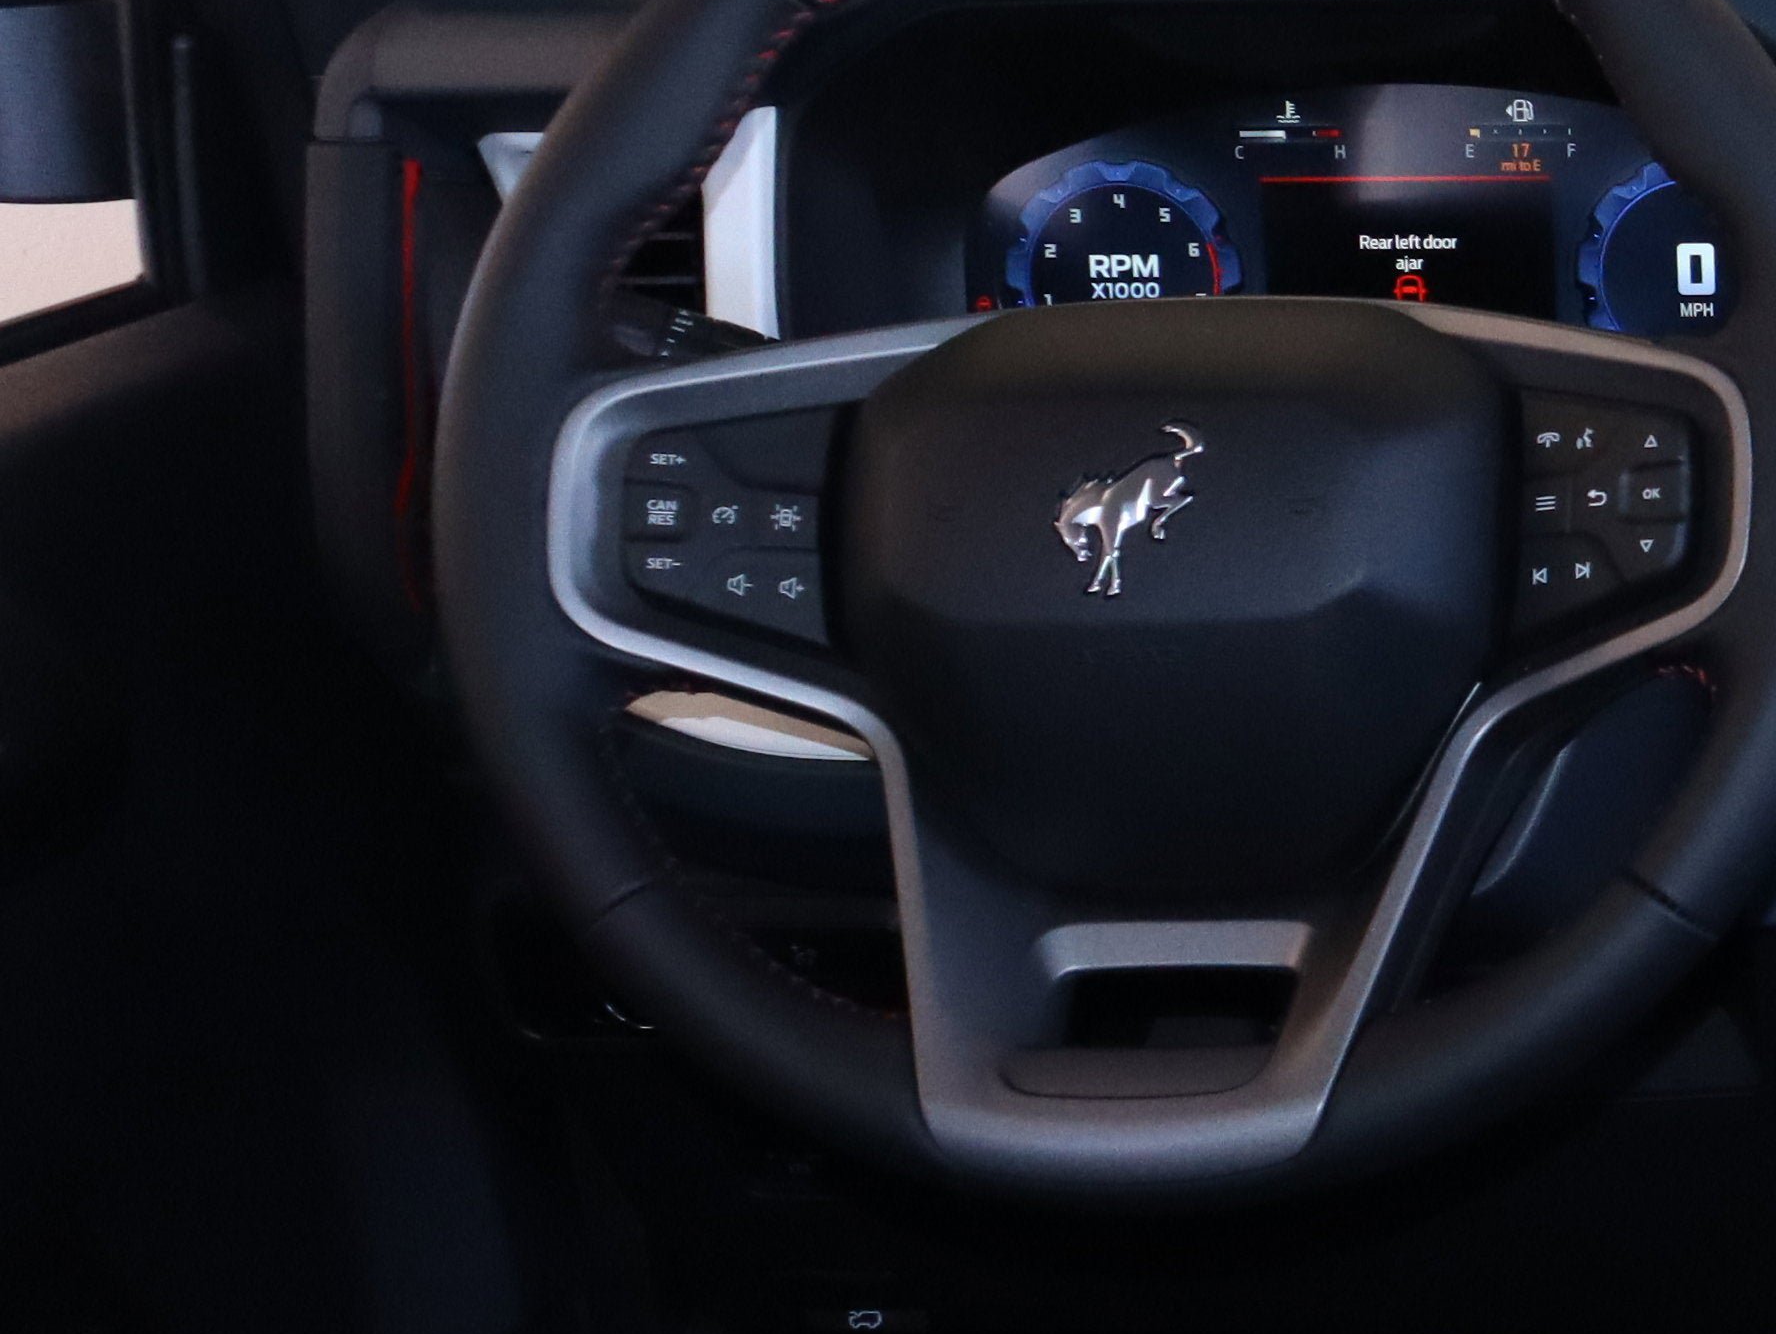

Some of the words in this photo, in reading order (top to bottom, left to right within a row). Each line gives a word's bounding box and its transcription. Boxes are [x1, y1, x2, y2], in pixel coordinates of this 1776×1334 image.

[1234, 145, 1244, 160] C
[1335, 145, 1346, 158] H
[1466, 145, 1475, 158] E
[1511, 143, 1531, 158] 17
[1567, 144, 1576, 158] F
[1113, 193, 1126, 208] 4
[1069, 208, 1082, 223] 3
[1159, 208, 1171, 222] 5
[1188, 242, 1200, 257] 6
[1359, 235, 1392, 250] Rear
[1395, 234, 1421, 250] left
[1423, 234, 1457, 250] door
[1044, 243, 1057, 258] 2
[1088, 254, 1160, 278] RPM
[1395, 256, 1424, 272] ajar
[1677, 243, 1716, 296] 0
[1091, 282, 1160, 299] X1000
[1044, 293, 1053, 306] 1
[1679, 302, 1714, 318] MPH
[1642, 487, 1661, 500] OK
[646, 499, 678, 511] CAN
[647, 514, 675, 526] RES
